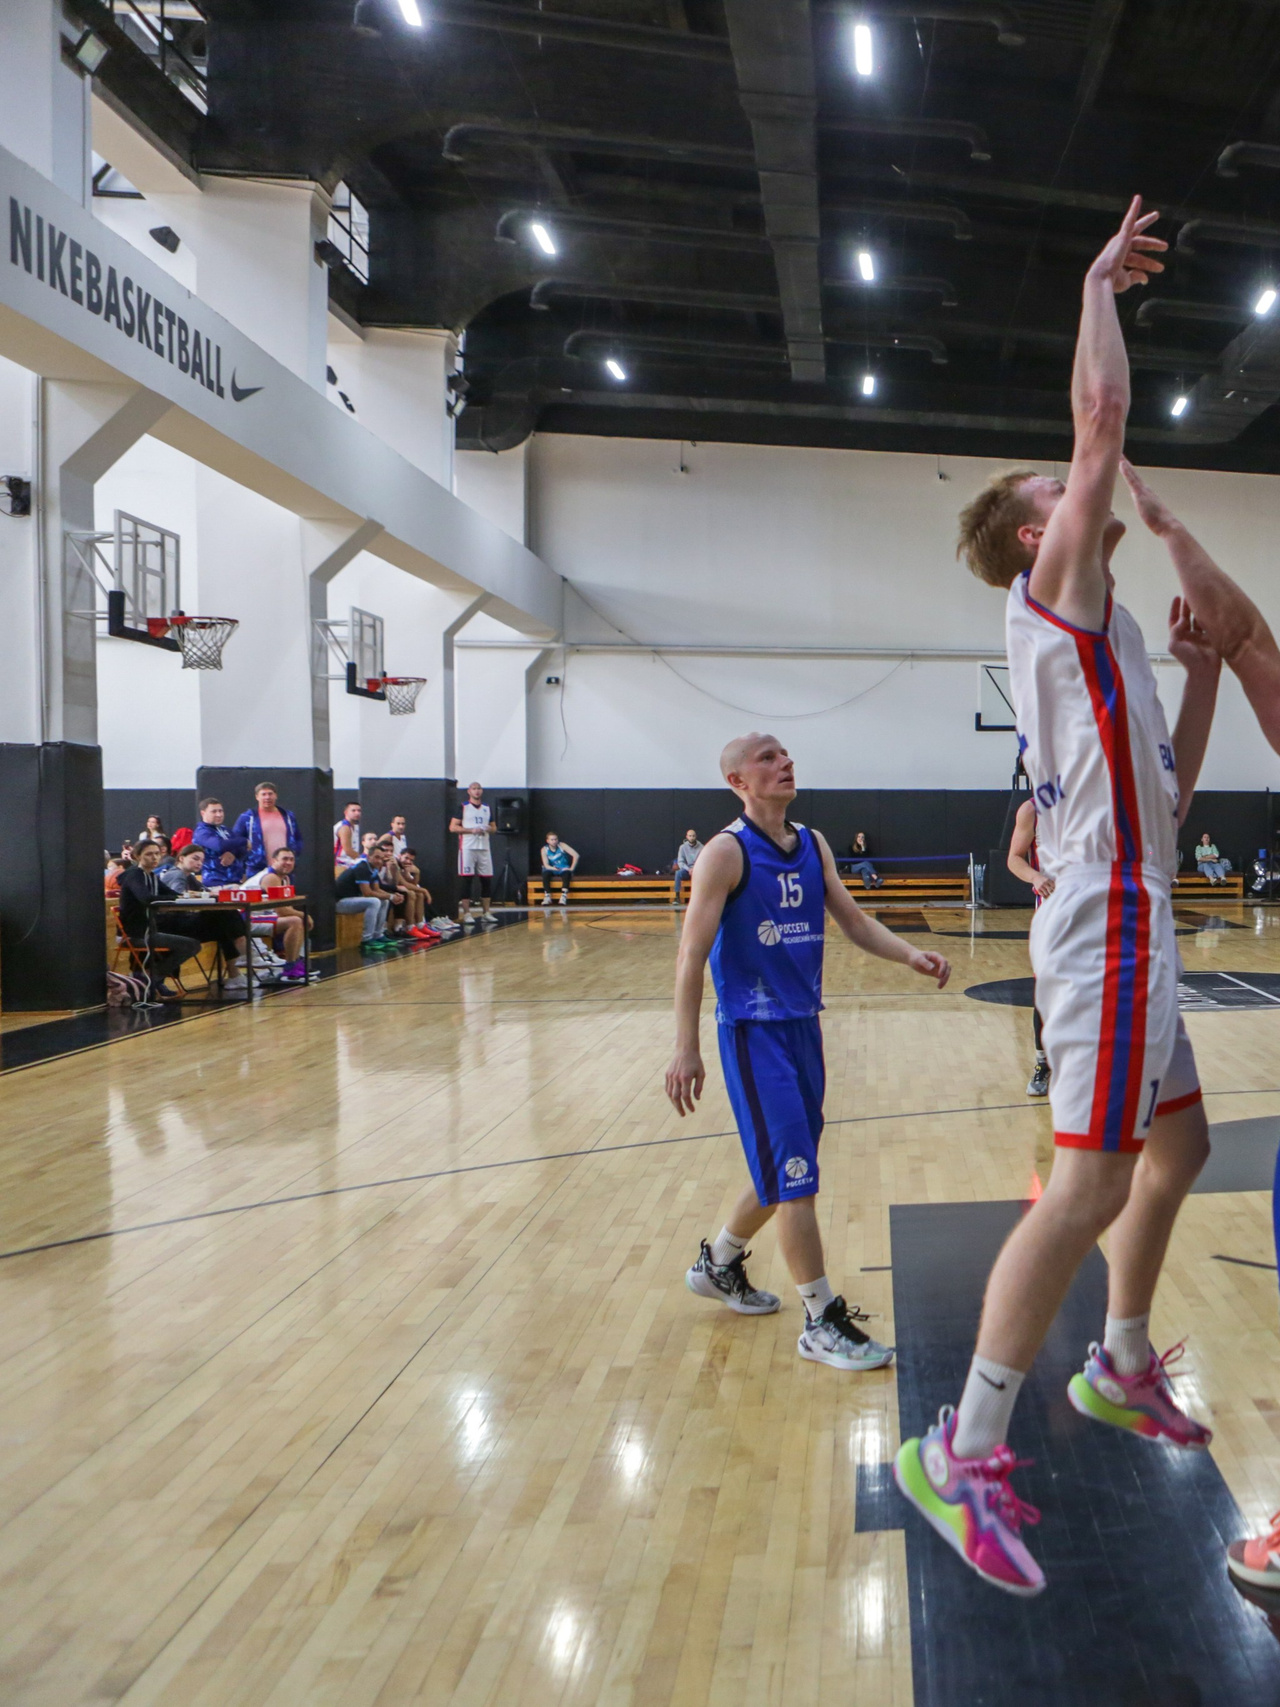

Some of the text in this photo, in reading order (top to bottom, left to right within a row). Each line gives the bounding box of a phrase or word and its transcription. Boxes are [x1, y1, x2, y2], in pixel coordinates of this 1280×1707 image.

[9, 196, 225, 399] NIKEBASKETBALL
[777, 872, 803, 908] 15
[778, 921, 811, 935] РОССЕТИ
